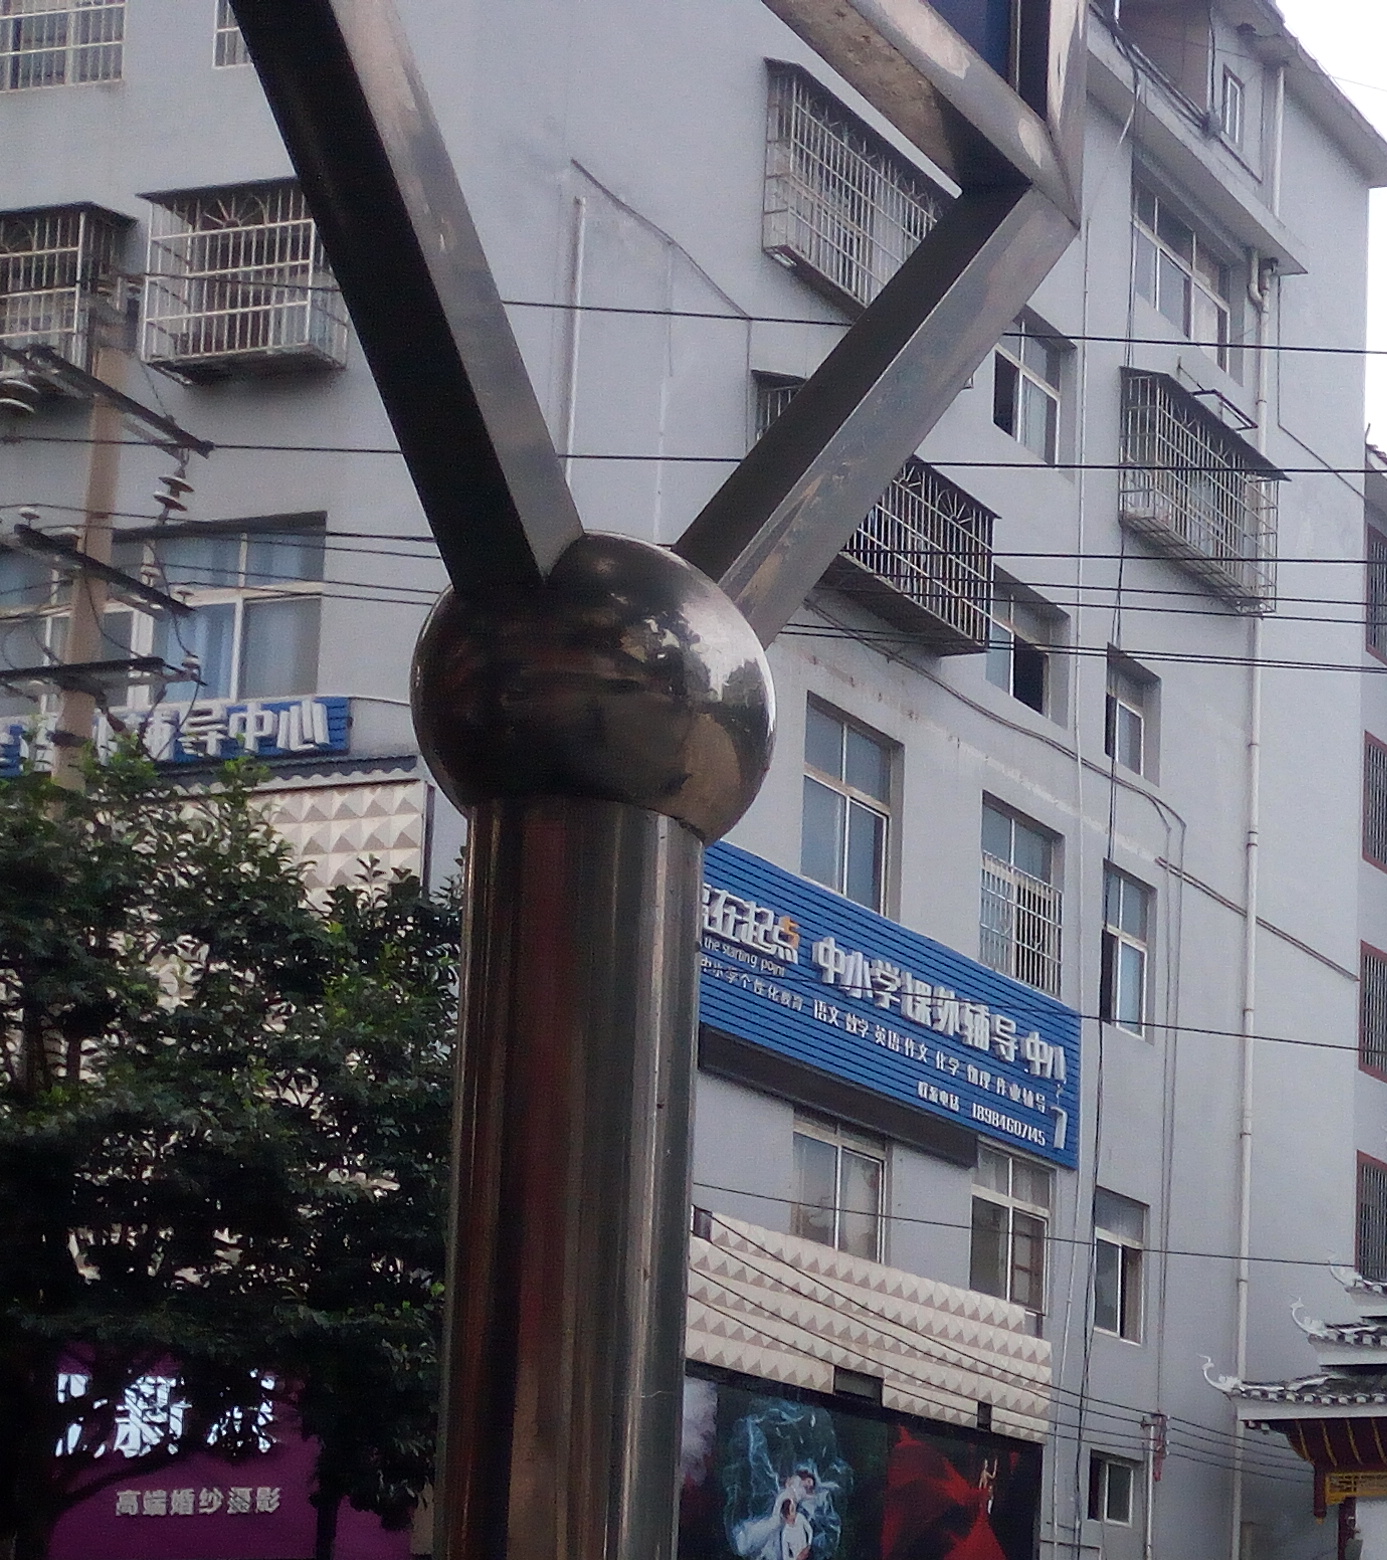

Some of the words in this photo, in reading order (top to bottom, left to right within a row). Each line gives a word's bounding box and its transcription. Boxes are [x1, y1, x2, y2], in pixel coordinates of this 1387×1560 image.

[702, 883, 799, 964] 在起点
[813, 998, 840, 1027] 语文
[844, 1012, 869, 1039] 数学
[873, 1024, 900, 1052] 英语
[903, 1036, 928, 1063] 作文
[934, 1049, 960, 1076] 化学
[965, 1063, 992, 1091] 物理
[995, 1075, 1047, 1114] 作业辅导
[115, 1487, 281, 1517] 高端婚纱摄影
